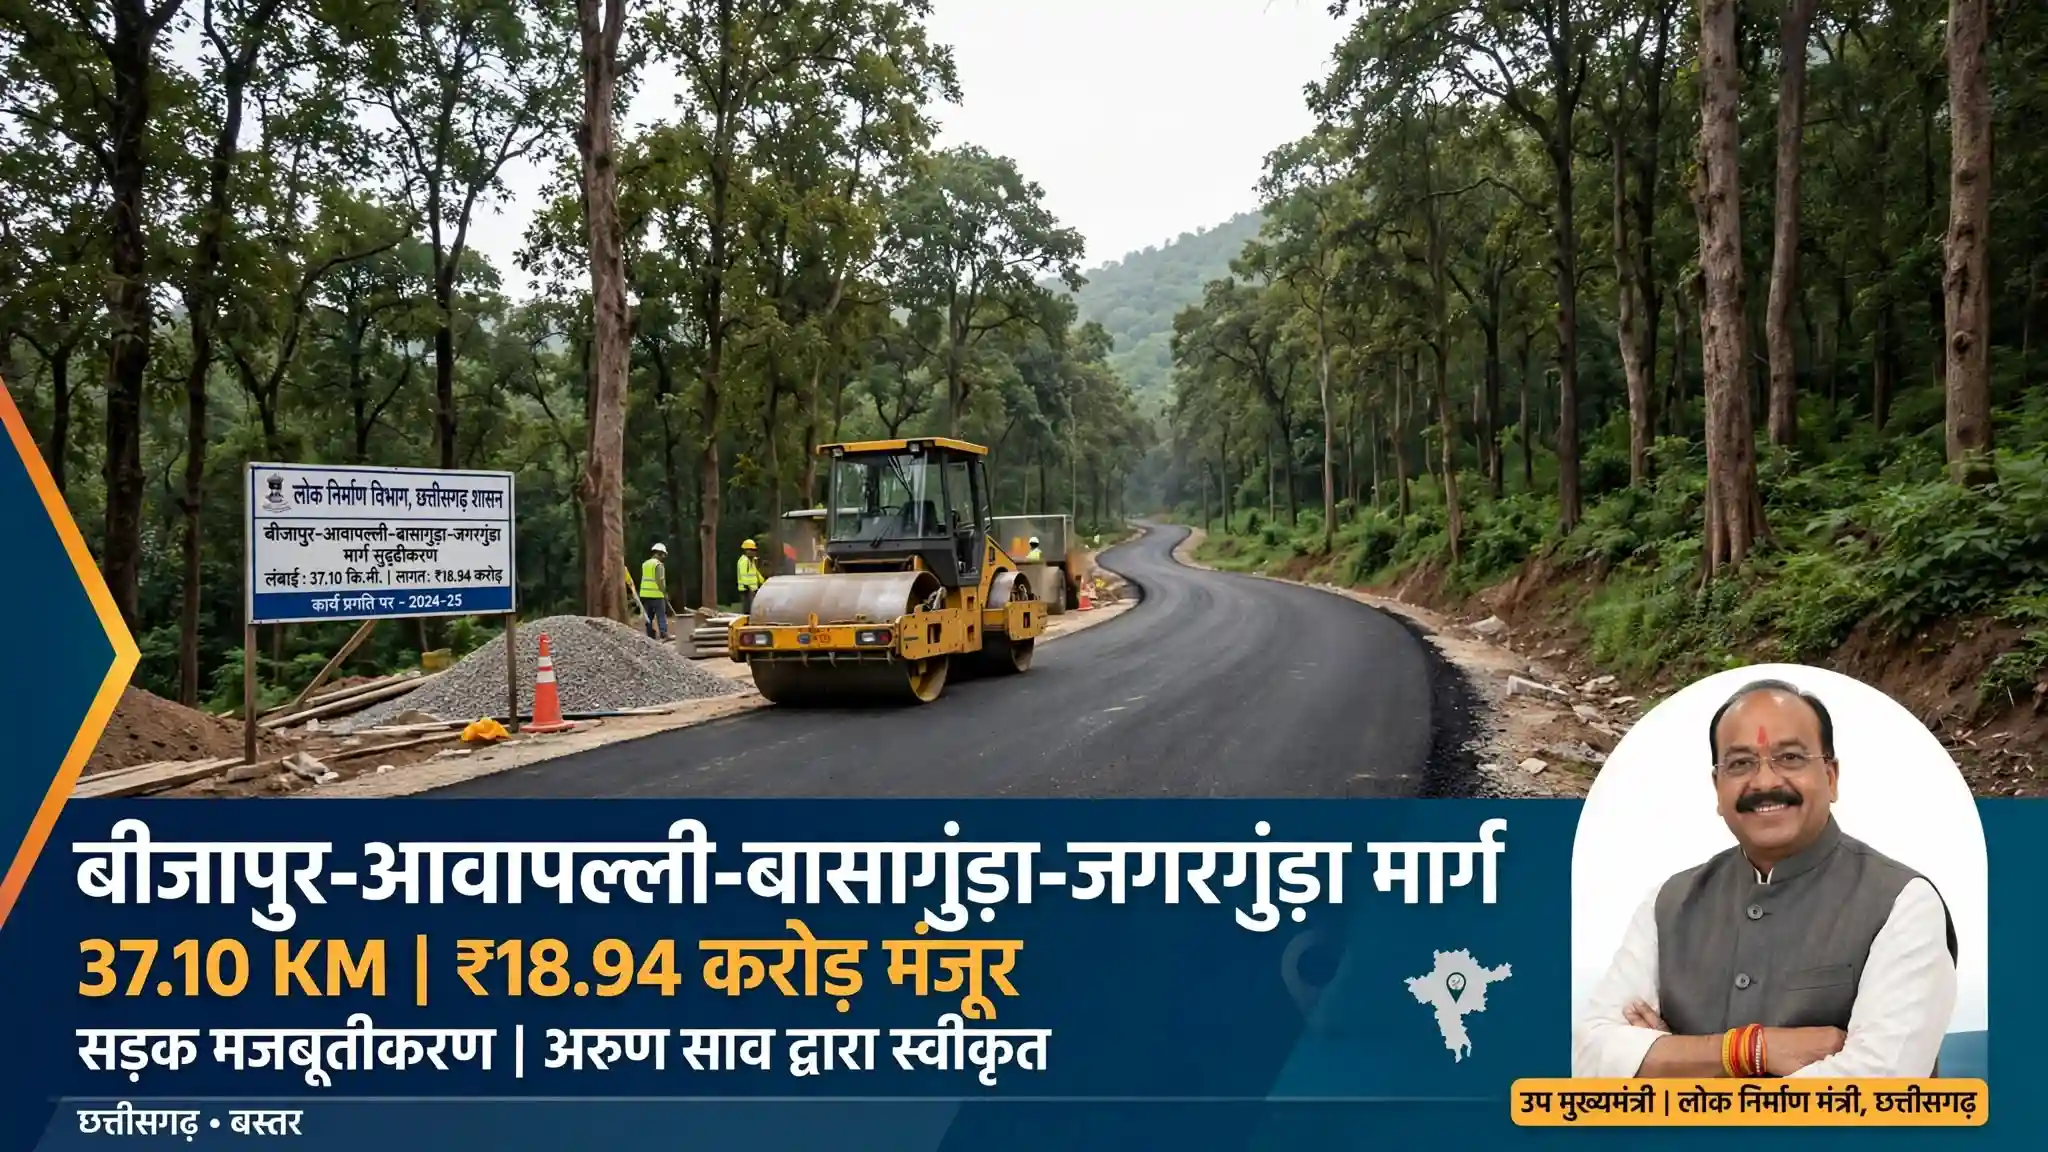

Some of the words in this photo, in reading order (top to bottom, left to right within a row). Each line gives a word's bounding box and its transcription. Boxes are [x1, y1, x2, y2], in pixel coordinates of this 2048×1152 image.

[292, 477, 324, 505] लोक
[326, 478, 367, 506] निर्माण
[370, 479, 412, 511] विभाग,
[415, 481, 469, 512] छत्तीसगढ़
[472, 489, 503, 509] शासन
[343, 544, 369, 563] मार्ग
[309, 571, 343, 586] 37.10
[434, 569, 472, 583] ₹18.94
[311, 593, 341, 612] कार्य
[343, 593, 375, 611] प्रगति
[378, 596, 395, 610] पर
[408, 593, 463, 609] 2024-25
